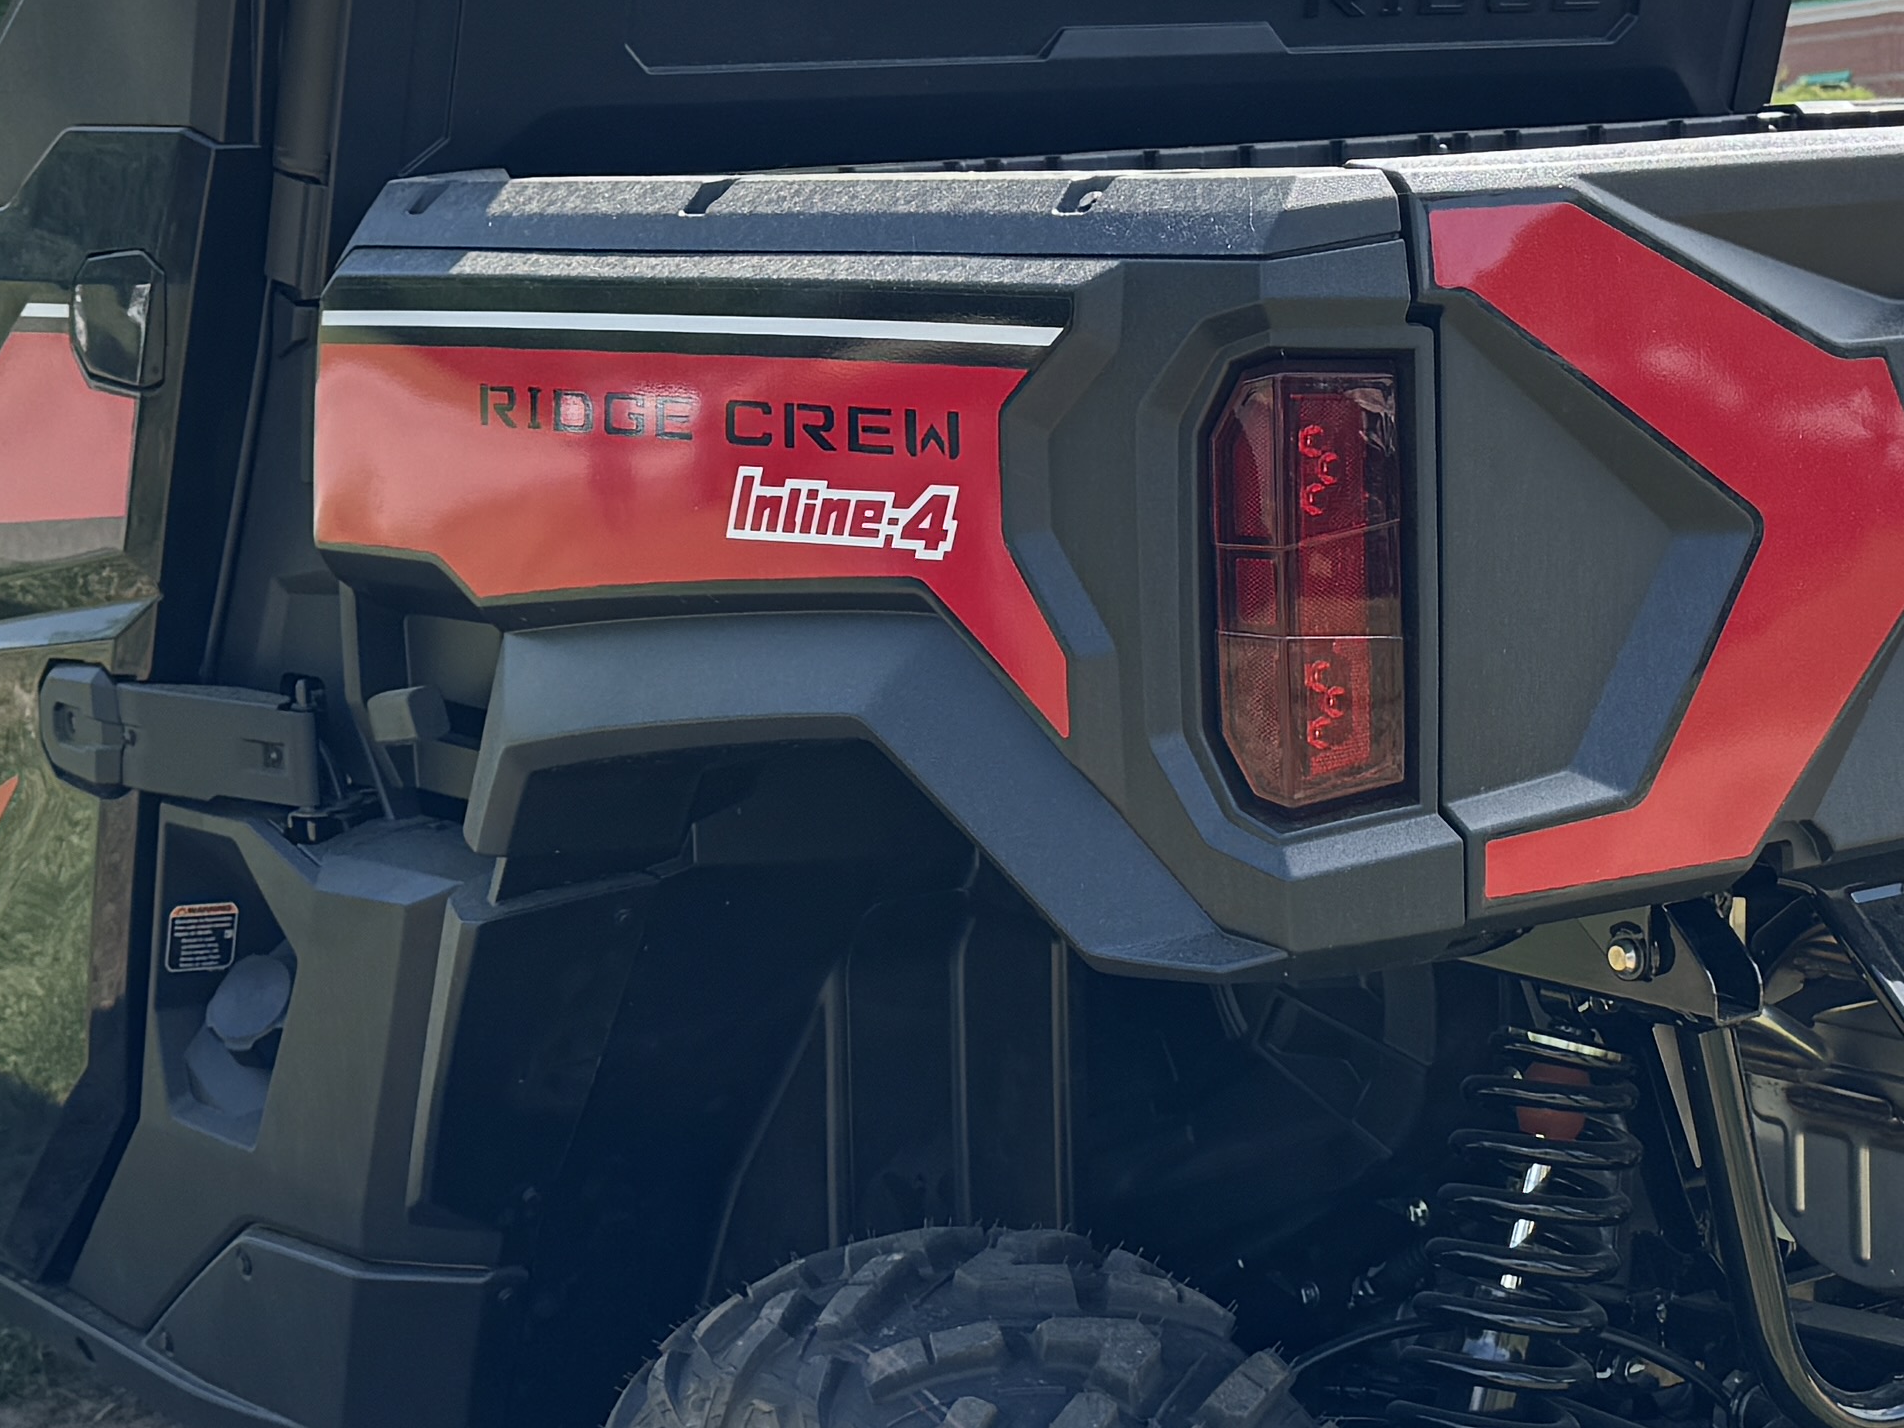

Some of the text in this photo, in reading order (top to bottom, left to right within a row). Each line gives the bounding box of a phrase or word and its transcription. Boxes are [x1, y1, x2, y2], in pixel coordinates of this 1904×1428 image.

[478, 383, 961, 461] RIDGE CREW
[726, 466, 959, 561] Inline-4
